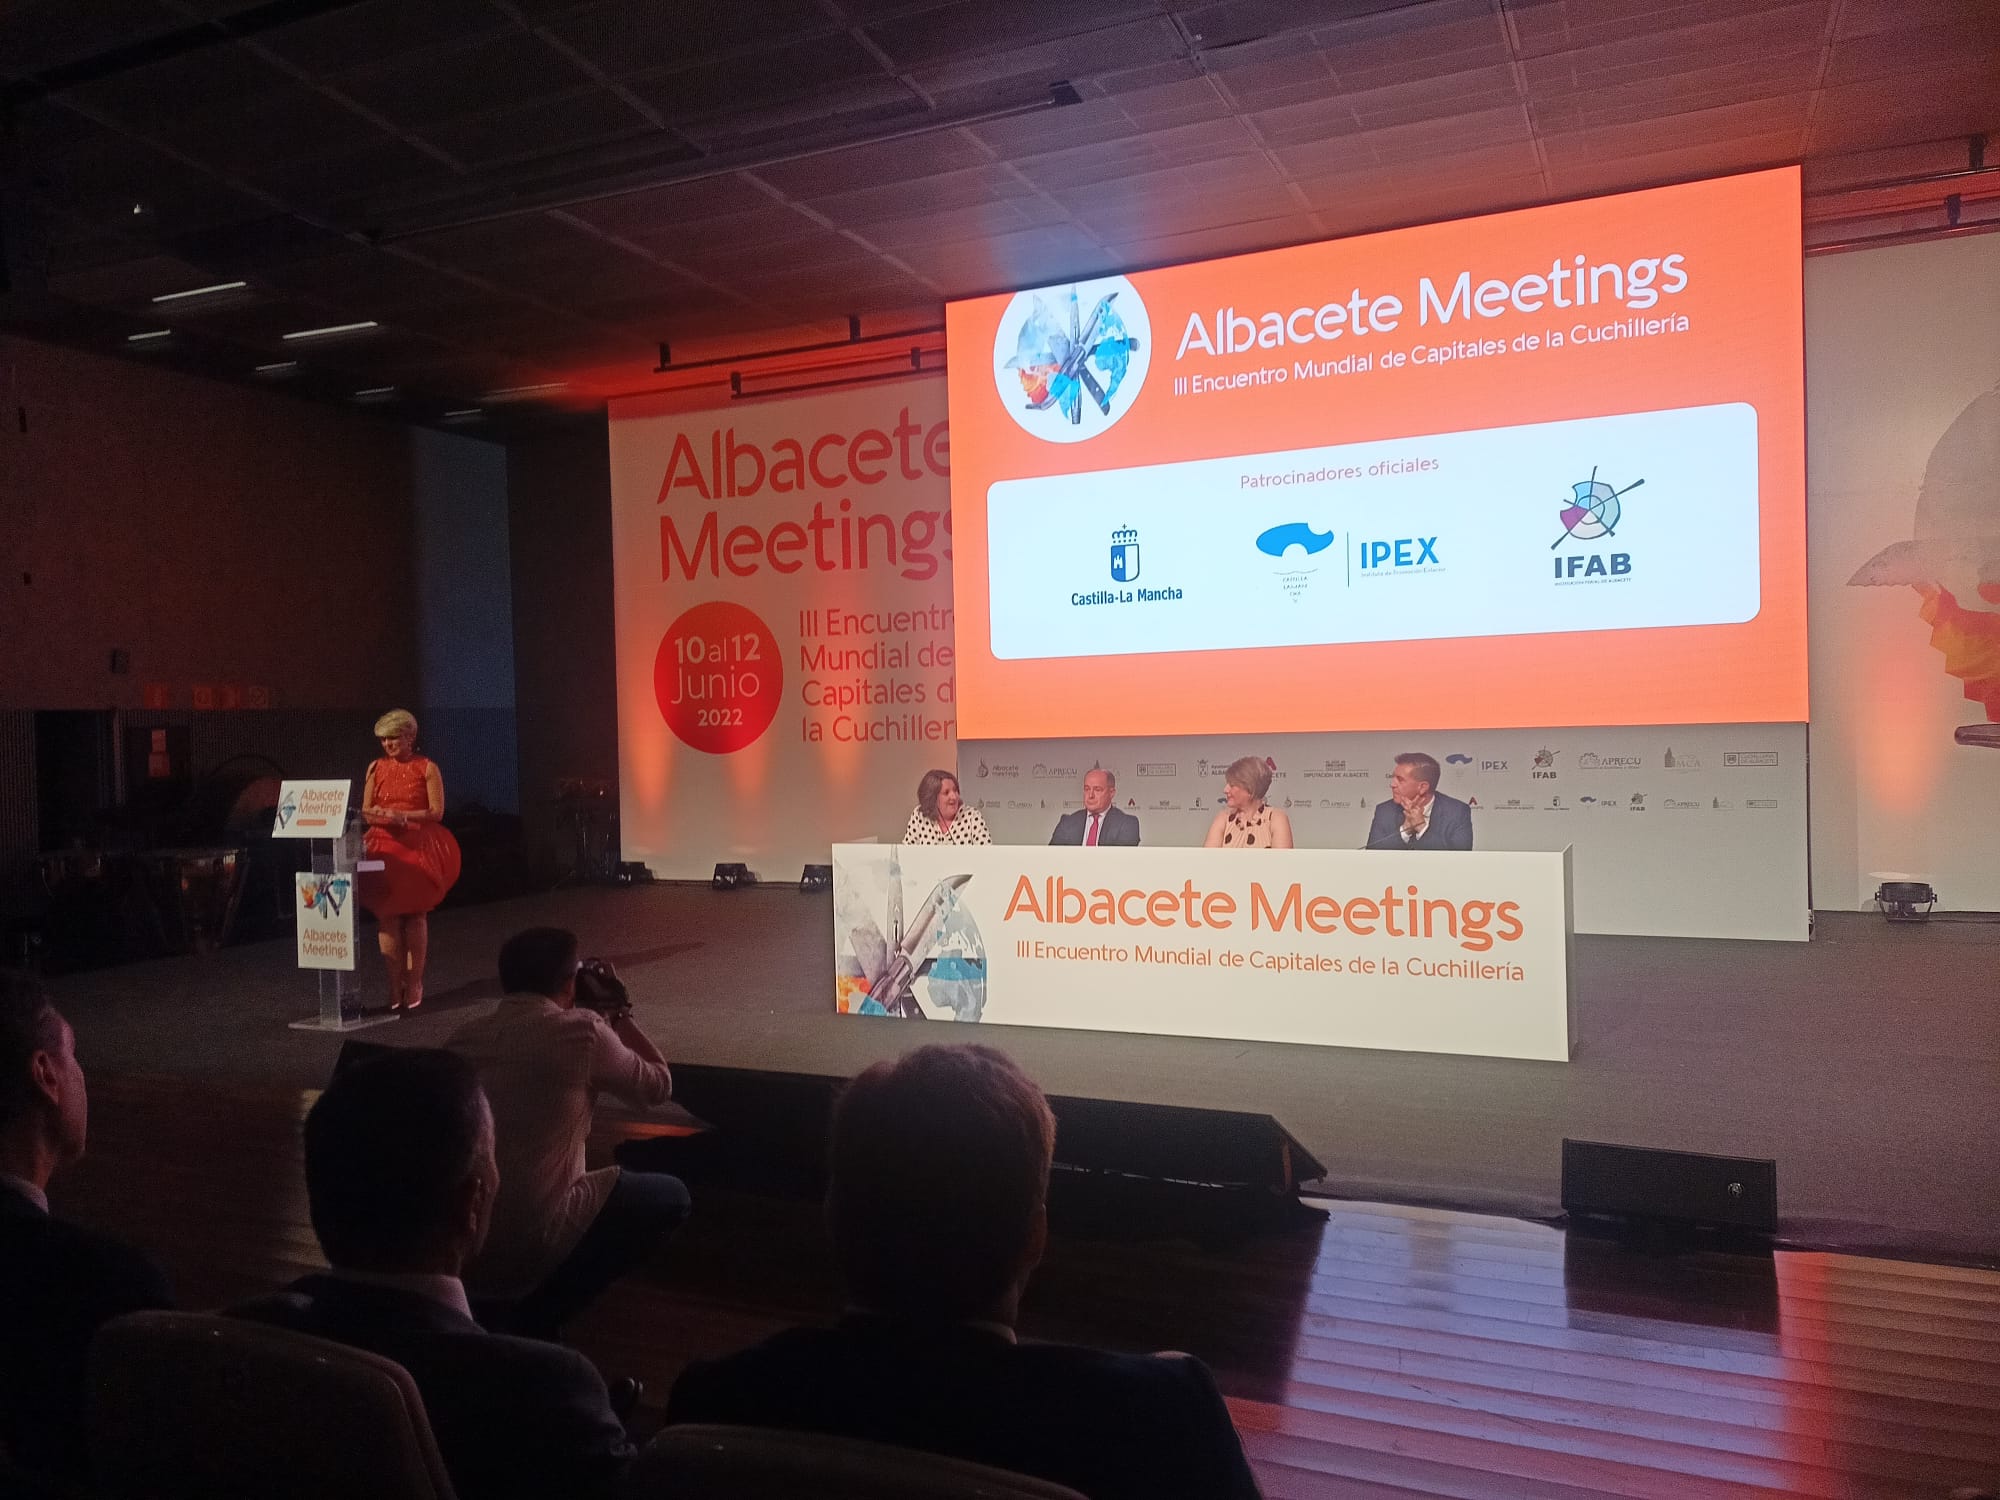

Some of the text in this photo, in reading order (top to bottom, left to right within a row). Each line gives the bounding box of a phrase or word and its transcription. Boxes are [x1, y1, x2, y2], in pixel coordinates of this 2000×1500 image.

[1175, 253, 1688, 361] Albacete Meetings
[1174, 313, 1689, 395] III Encuentro Mundial de Capitales de la Cuchillería
[656, 406, 950, 504] Albacete
[1241, 458, 1439, 488] Patrocinadores oficiales
[1361, 536, 1439, 569] IPEX
[1555, 553, 1632, 578] IFAB
[1071, 586, 1183, 606] Castilla-La Mancha
[800, 603, 954, 637] III Encuentr
[674, 633, 761, 664] 10 al 12
[800, 640, 954, 672] Mundial de
[671, 665, 760, 704] Junio
[802, 676, 954, 712] Capitales d
[697, 709, 743, 727] 2022
[802, 714, 955, 742] la Cuchiller
[1481, 761, 1508, 770] IPEX
[1532, 771, 1557, 779] IFAB
[1601, 757, 1641, 766] APRECU
[298, 801, 342, 816] Meetings
[300, 788, 344, 801] Albacete
[1002, 874, 1523, 952] Albacete Meetings
[303, 929, 346, 943] Albacete
[302, 943, 348, 960] Meetings
[1016, 940, 1524, 981] III Encuentro Mundial de Capitales de la Cuchillería
